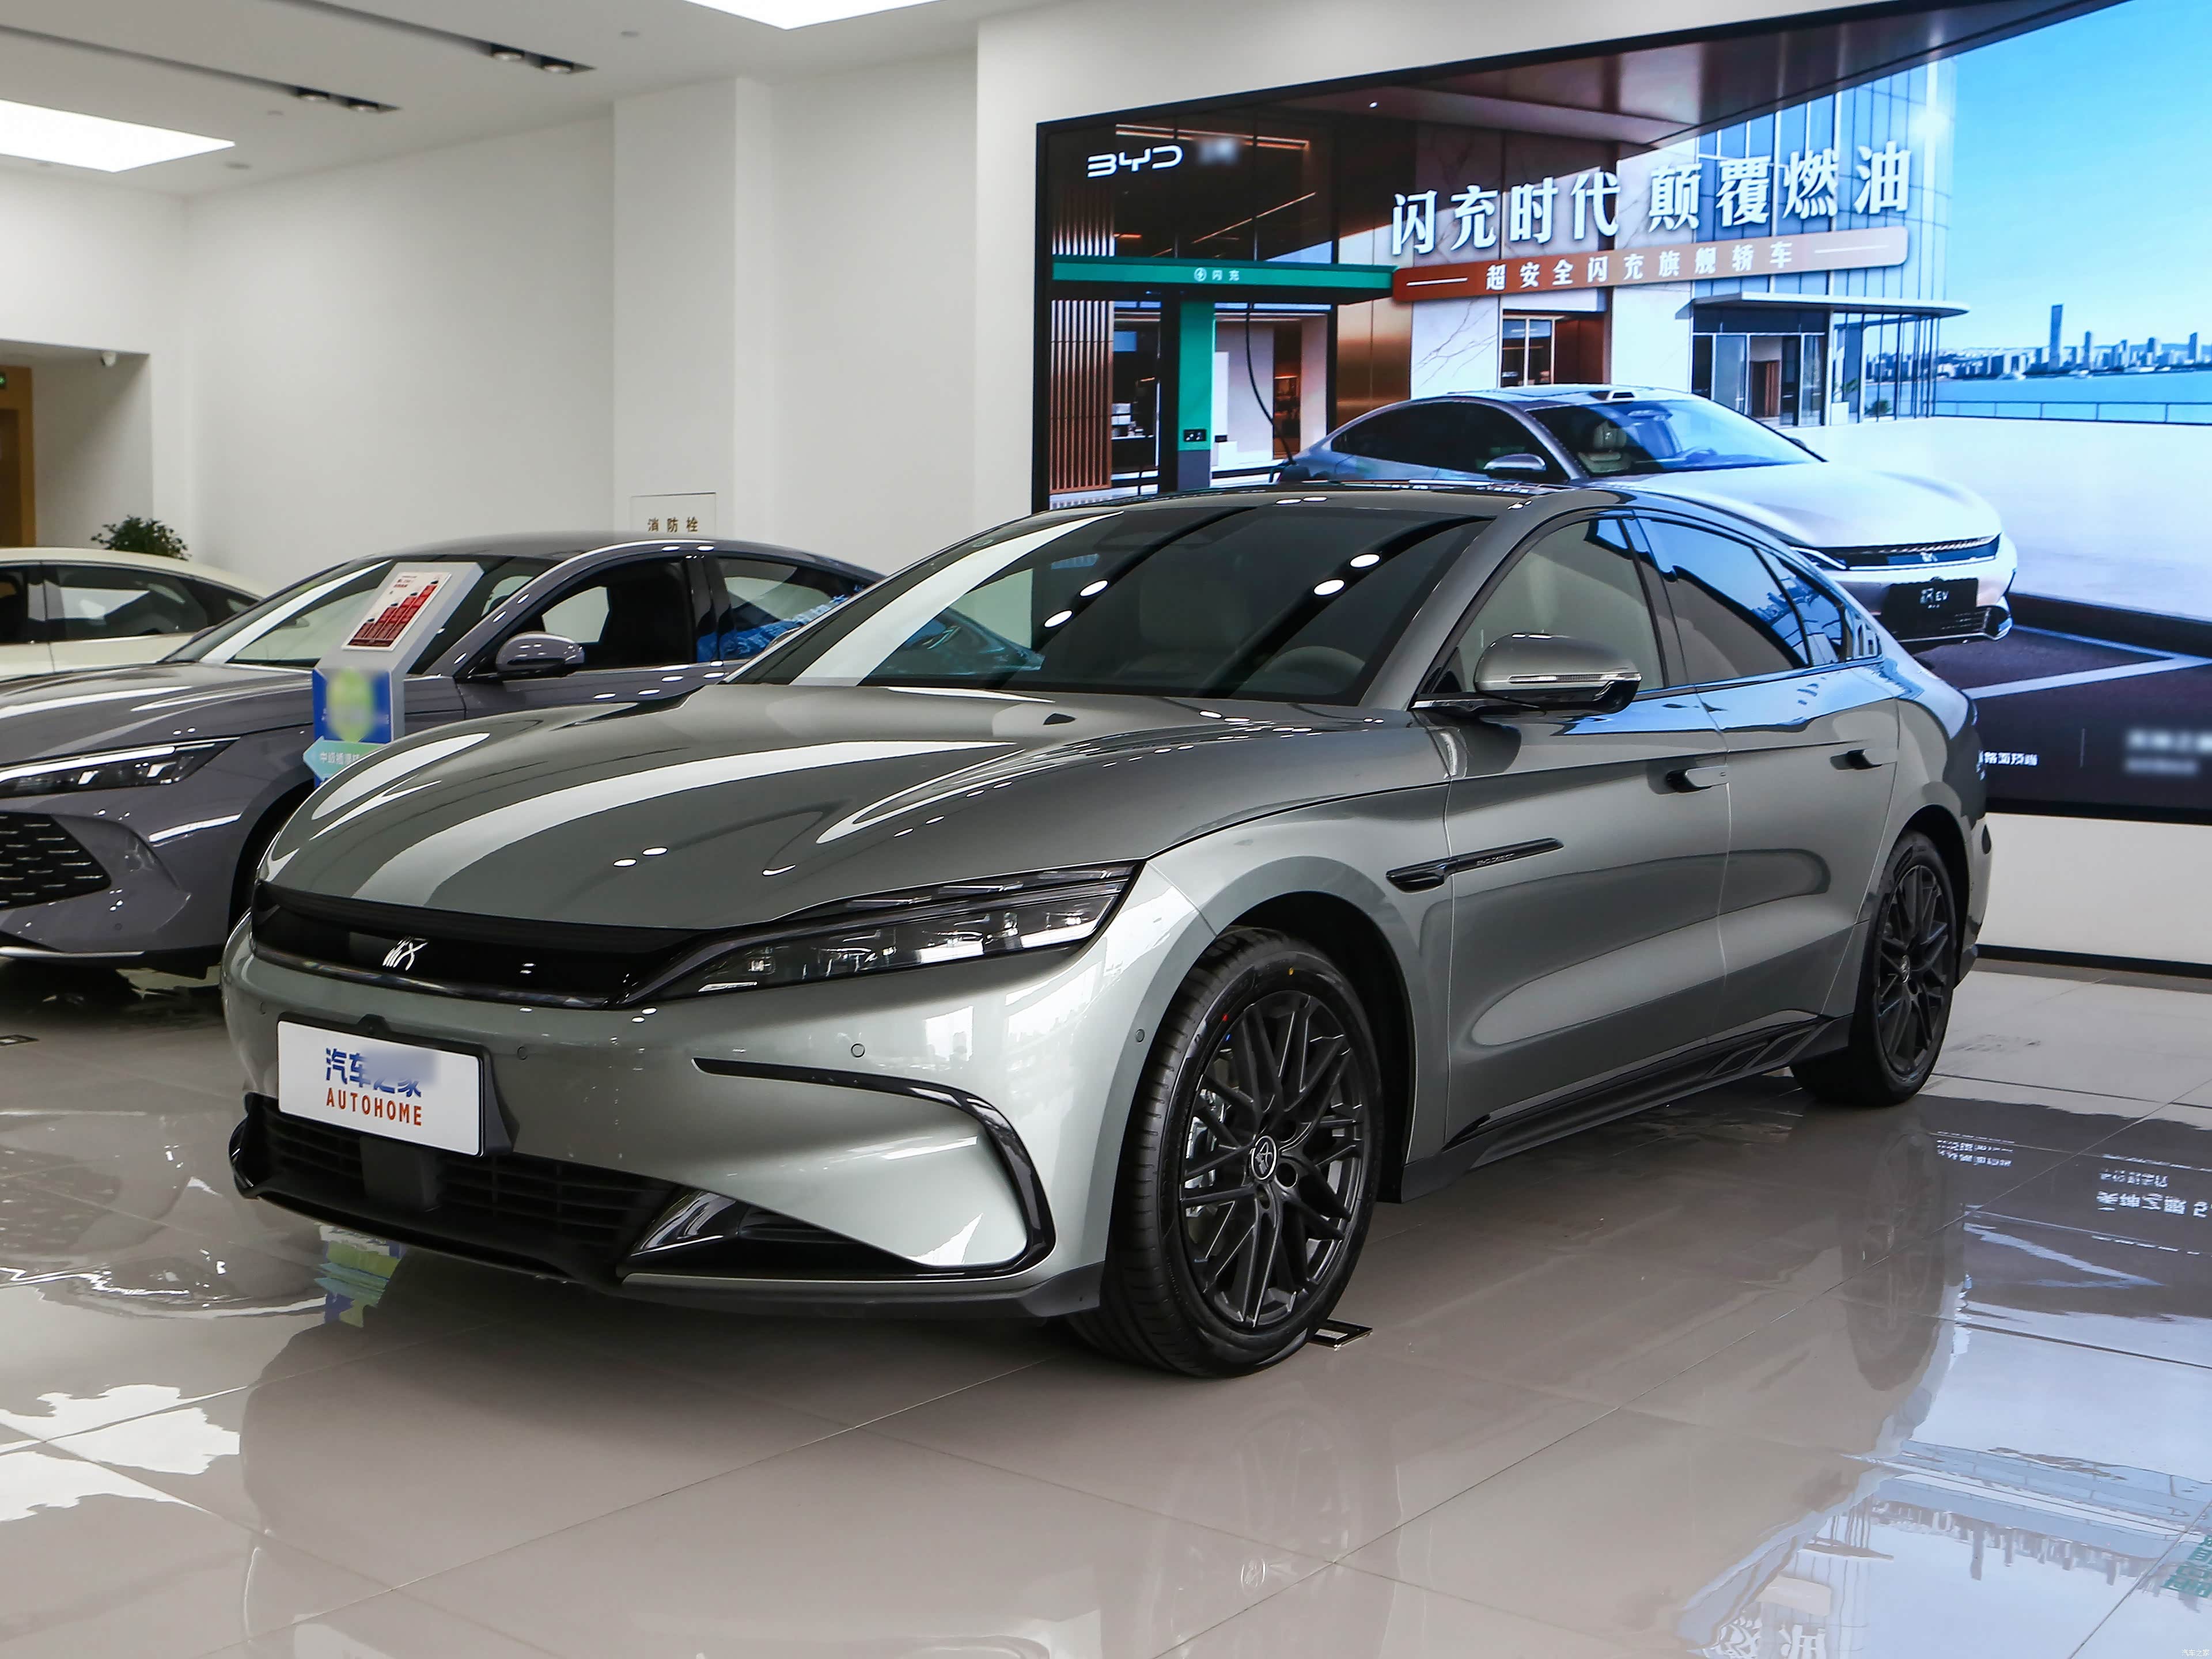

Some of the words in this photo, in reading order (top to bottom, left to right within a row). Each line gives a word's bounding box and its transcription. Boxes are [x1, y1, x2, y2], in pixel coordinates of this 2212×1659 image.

[1087, 145, 1184, 178] BYD
[1390, 171, 1622, 256] 闪充时代
[1647, 140, 1912, 233] 颠覆燃油
[1212, 269, 1240, 282] 闪充
[1485, 241, 1794, 292] 超安全闪充旗舰轿车
[647, 516, 699, 533] 消防栓
[326, 1087, 422, 1126] AUTOHOME
